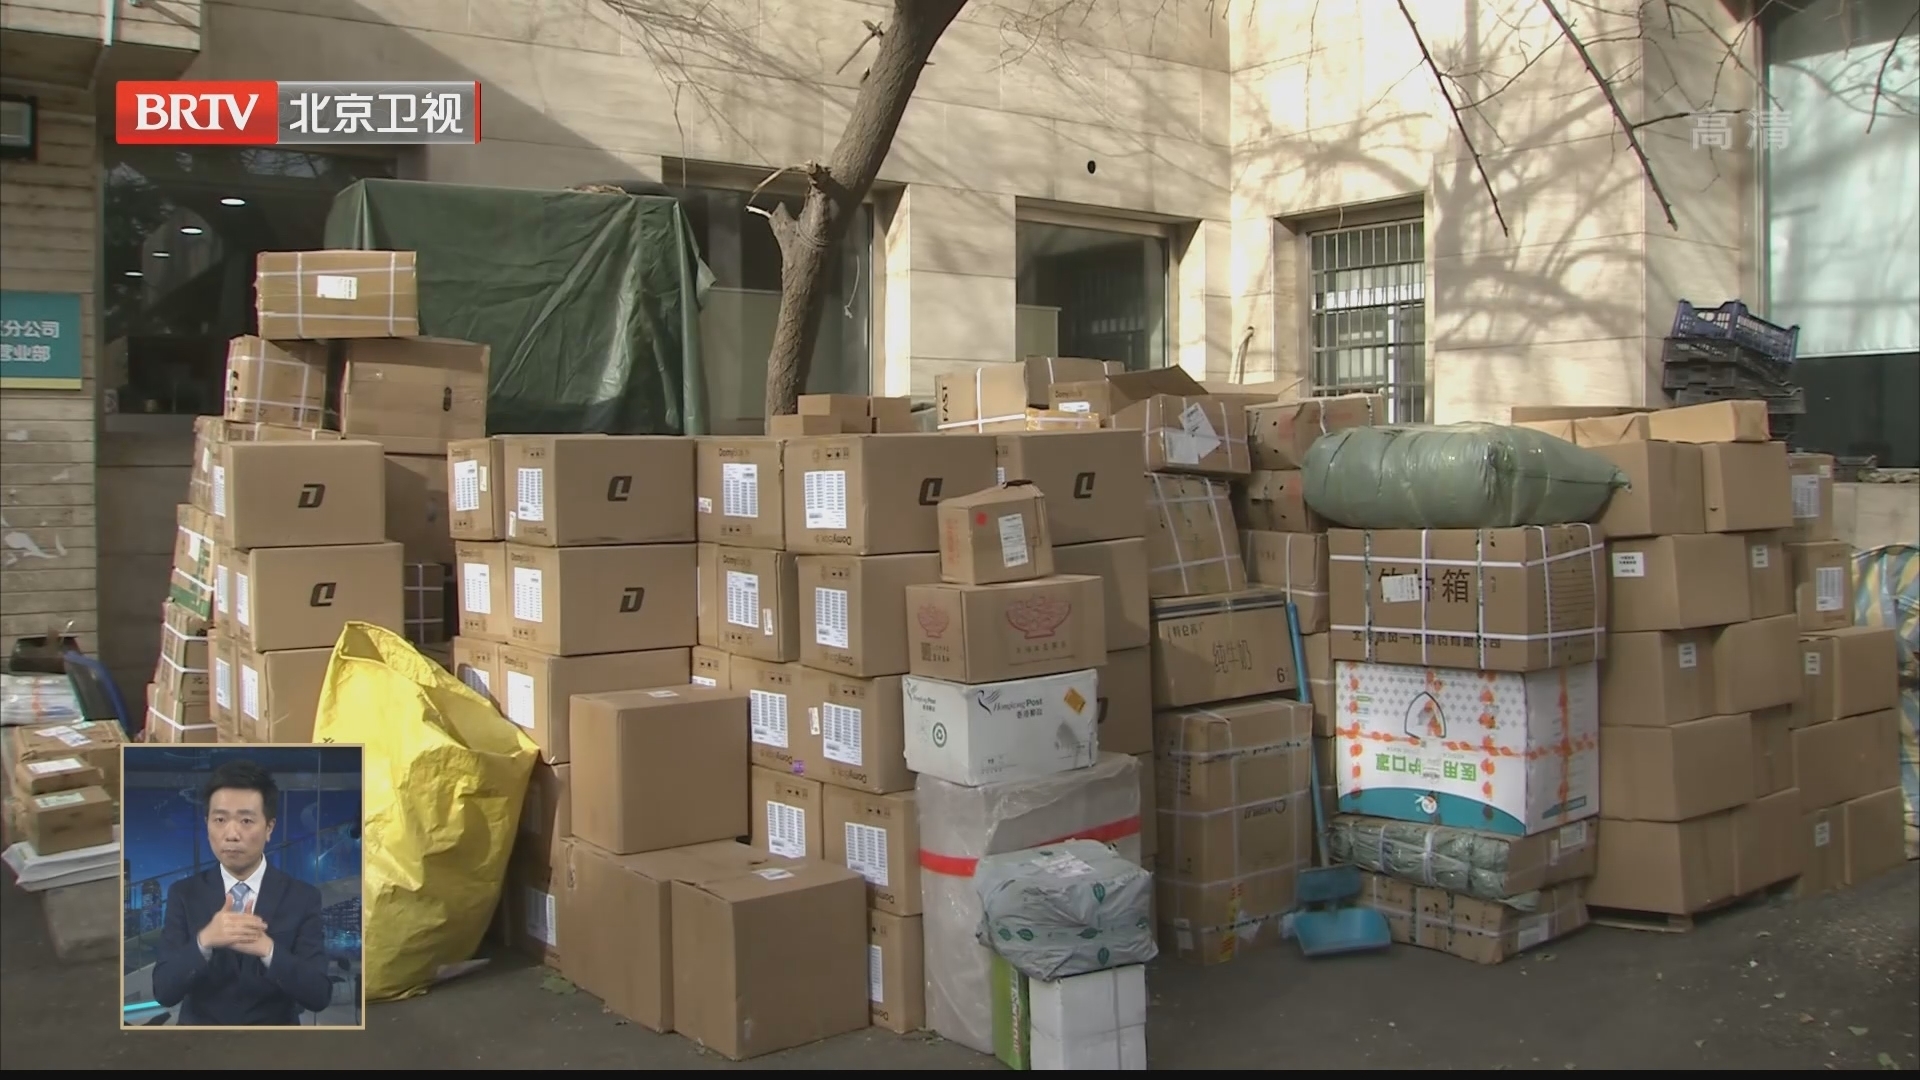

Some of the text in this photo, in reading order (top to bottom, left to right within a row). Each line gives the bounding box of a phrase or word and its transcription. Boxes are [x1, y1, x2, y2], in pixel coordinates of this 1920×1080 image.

[0, 320, 60, 338] 分公司
[1375, 753, 1477, 782] 医用护口罩
